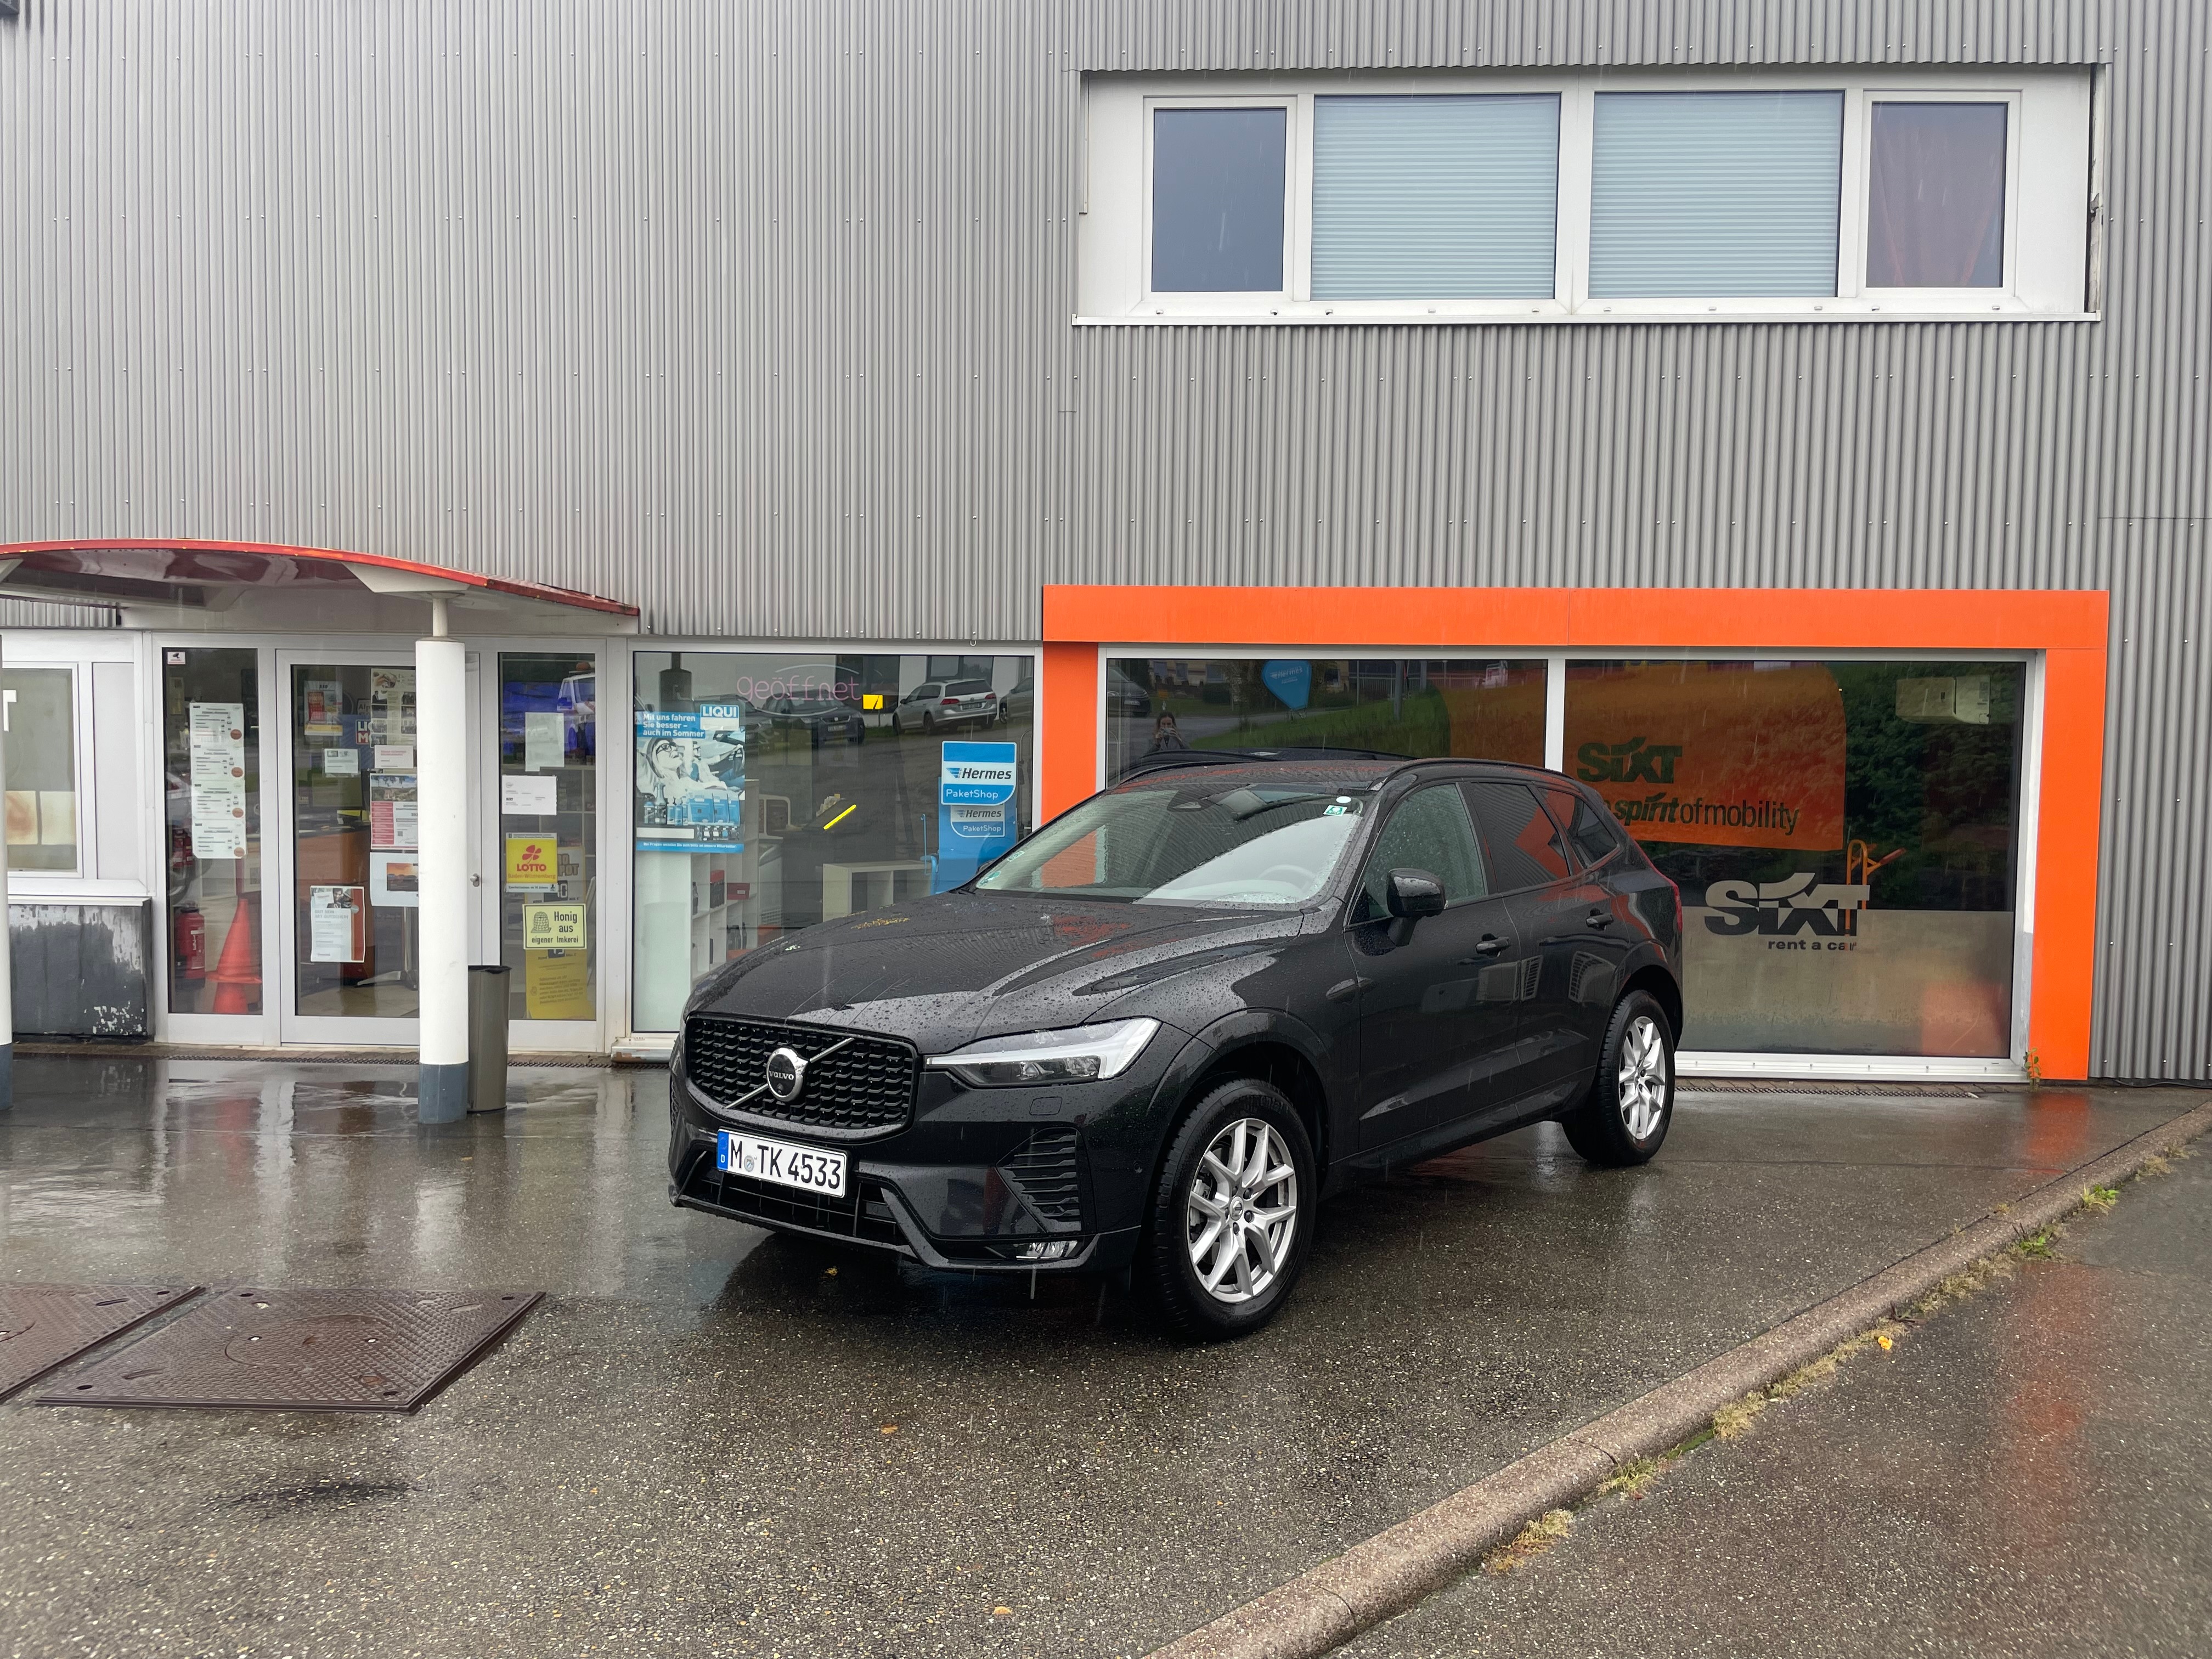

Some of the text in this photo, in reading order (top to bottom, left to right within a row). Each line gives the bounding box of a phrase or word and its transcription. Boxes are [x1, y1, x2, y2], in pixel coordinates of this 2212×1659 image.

[736, 675, 862, 702] geöffnet
[702, 706, 737, 718] LIQUI
[671, 714, 696, 722] fahren
[962, 768, 1012, 780] Hermes
[946, 788, 998, 800] PaketShop
[965, 809, 1002, 818] Hermes
[517, 864, 547, 872] LOTTO
[554, 911, 578, 924] Honig
[532, 935, 554, 944] eigener
[1768, 940, 1857, 951] rent a car
[769, 1070, 794, 1080] VOLVO
[720, 1139, 841, 1189] D M TK 4533
